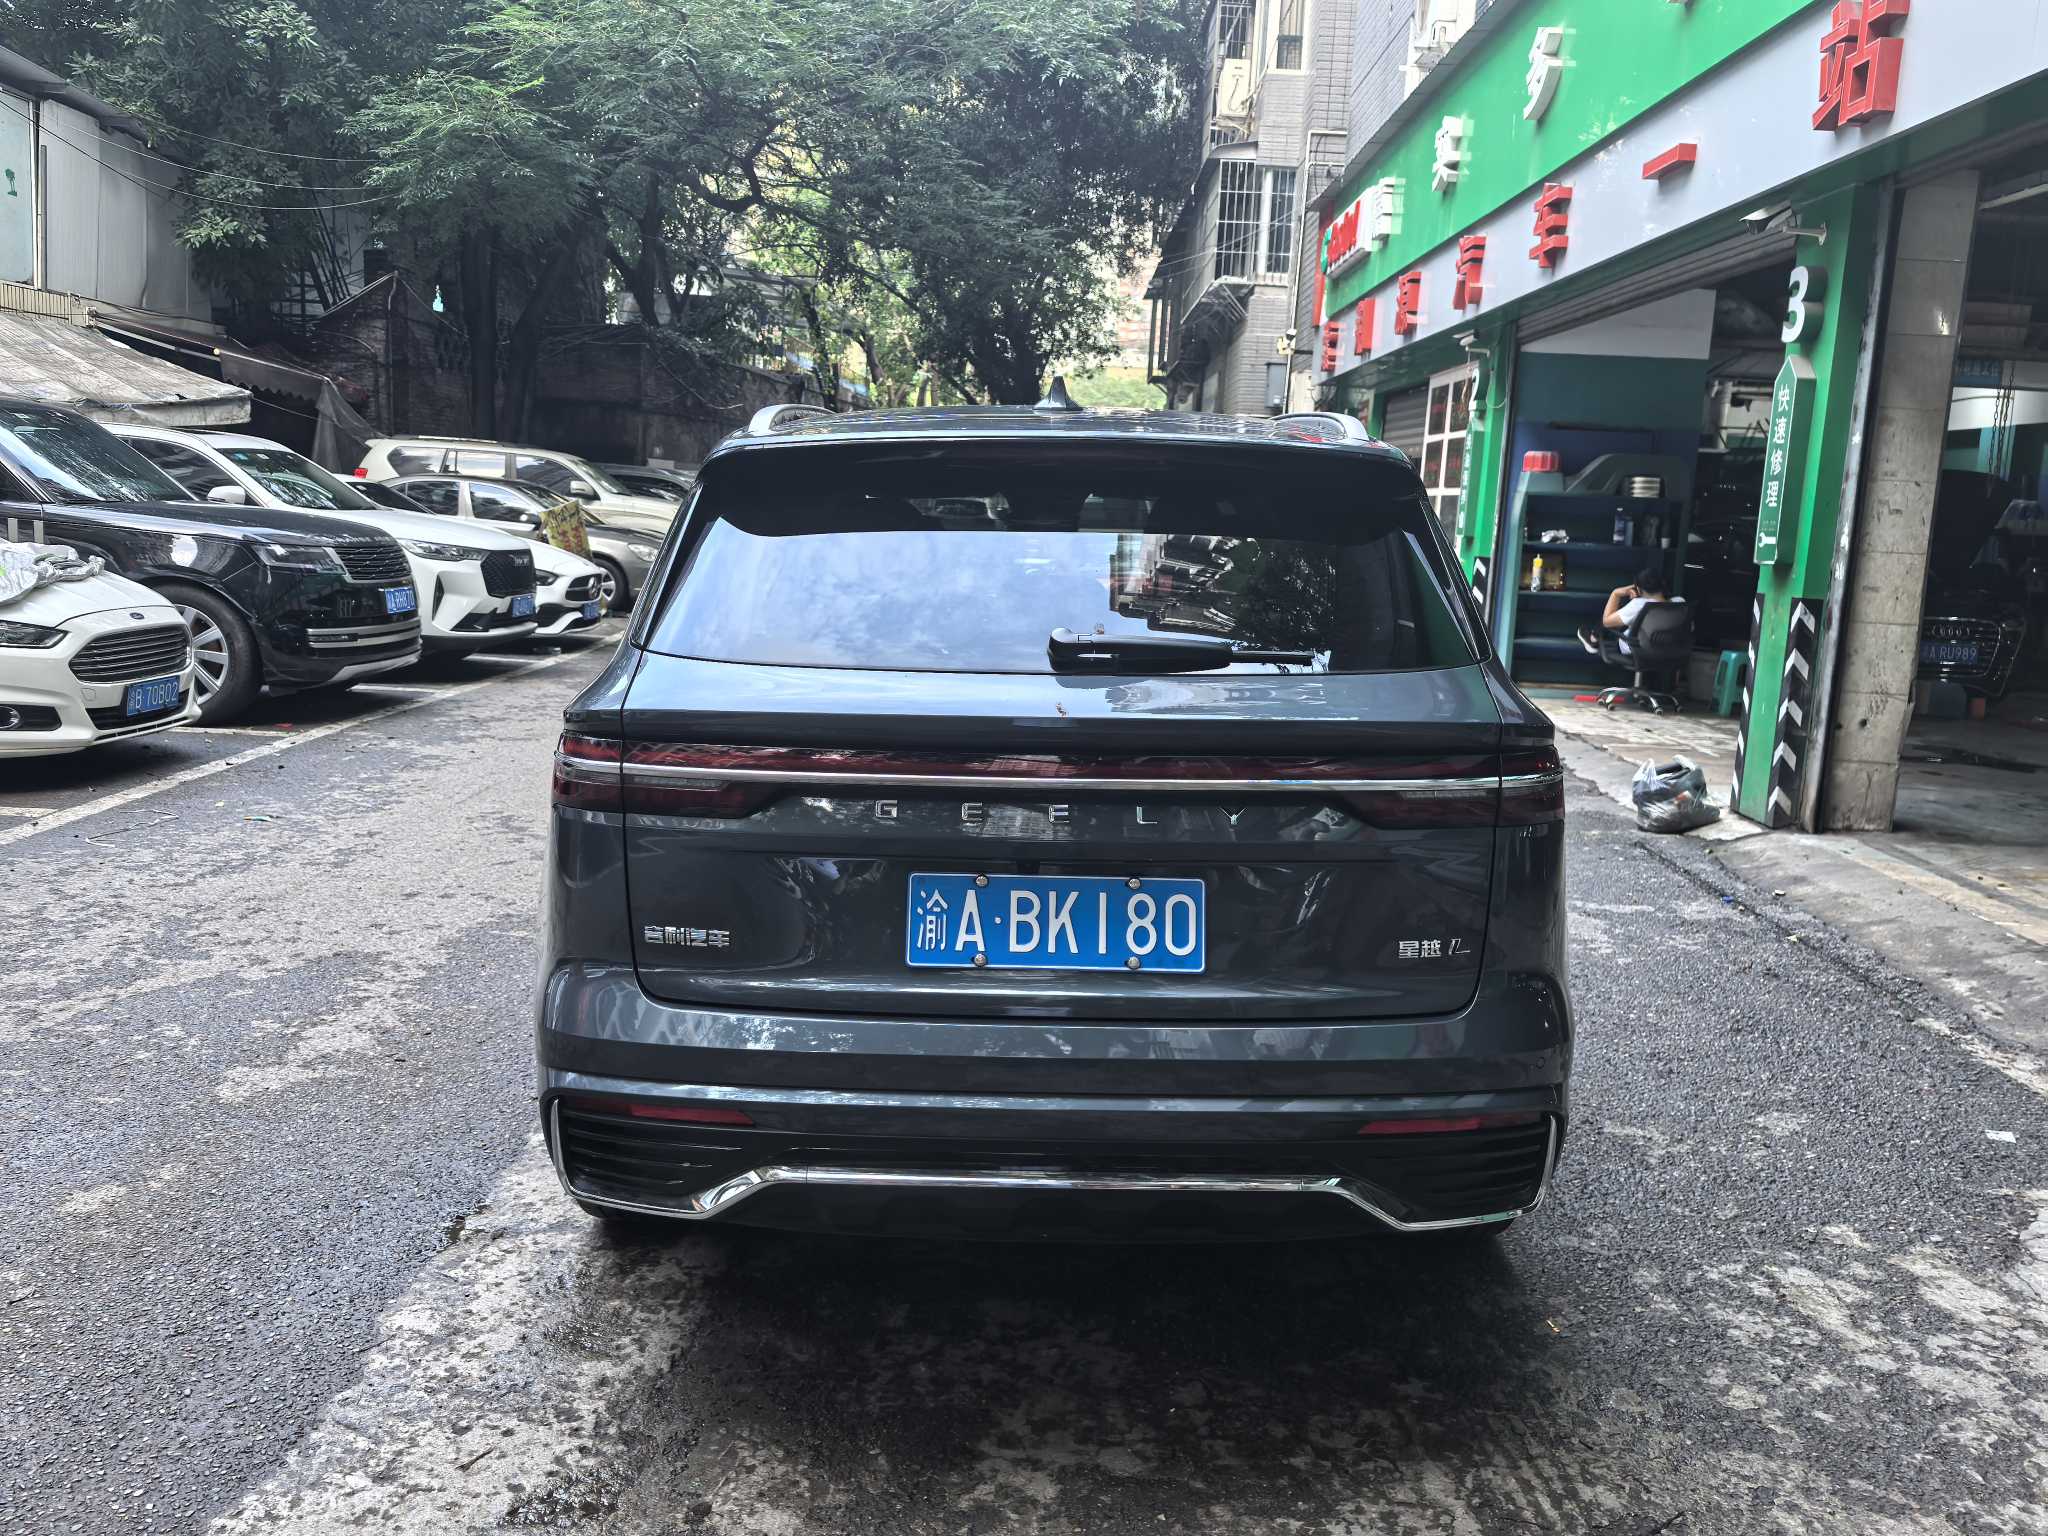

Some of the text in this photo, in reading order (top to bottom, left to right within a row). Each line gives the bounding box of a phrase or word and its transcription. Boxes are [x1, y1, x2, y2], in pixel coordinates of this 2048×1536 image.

[1781, 265, 1809, 343] 3
[1766, 384, 1792, 508] 快速修理
[874, 800, 1247, 825] GEELY
[644, 925, 730, 947] 吉利汽车
[1399, 939, 1442, 959] 星越
